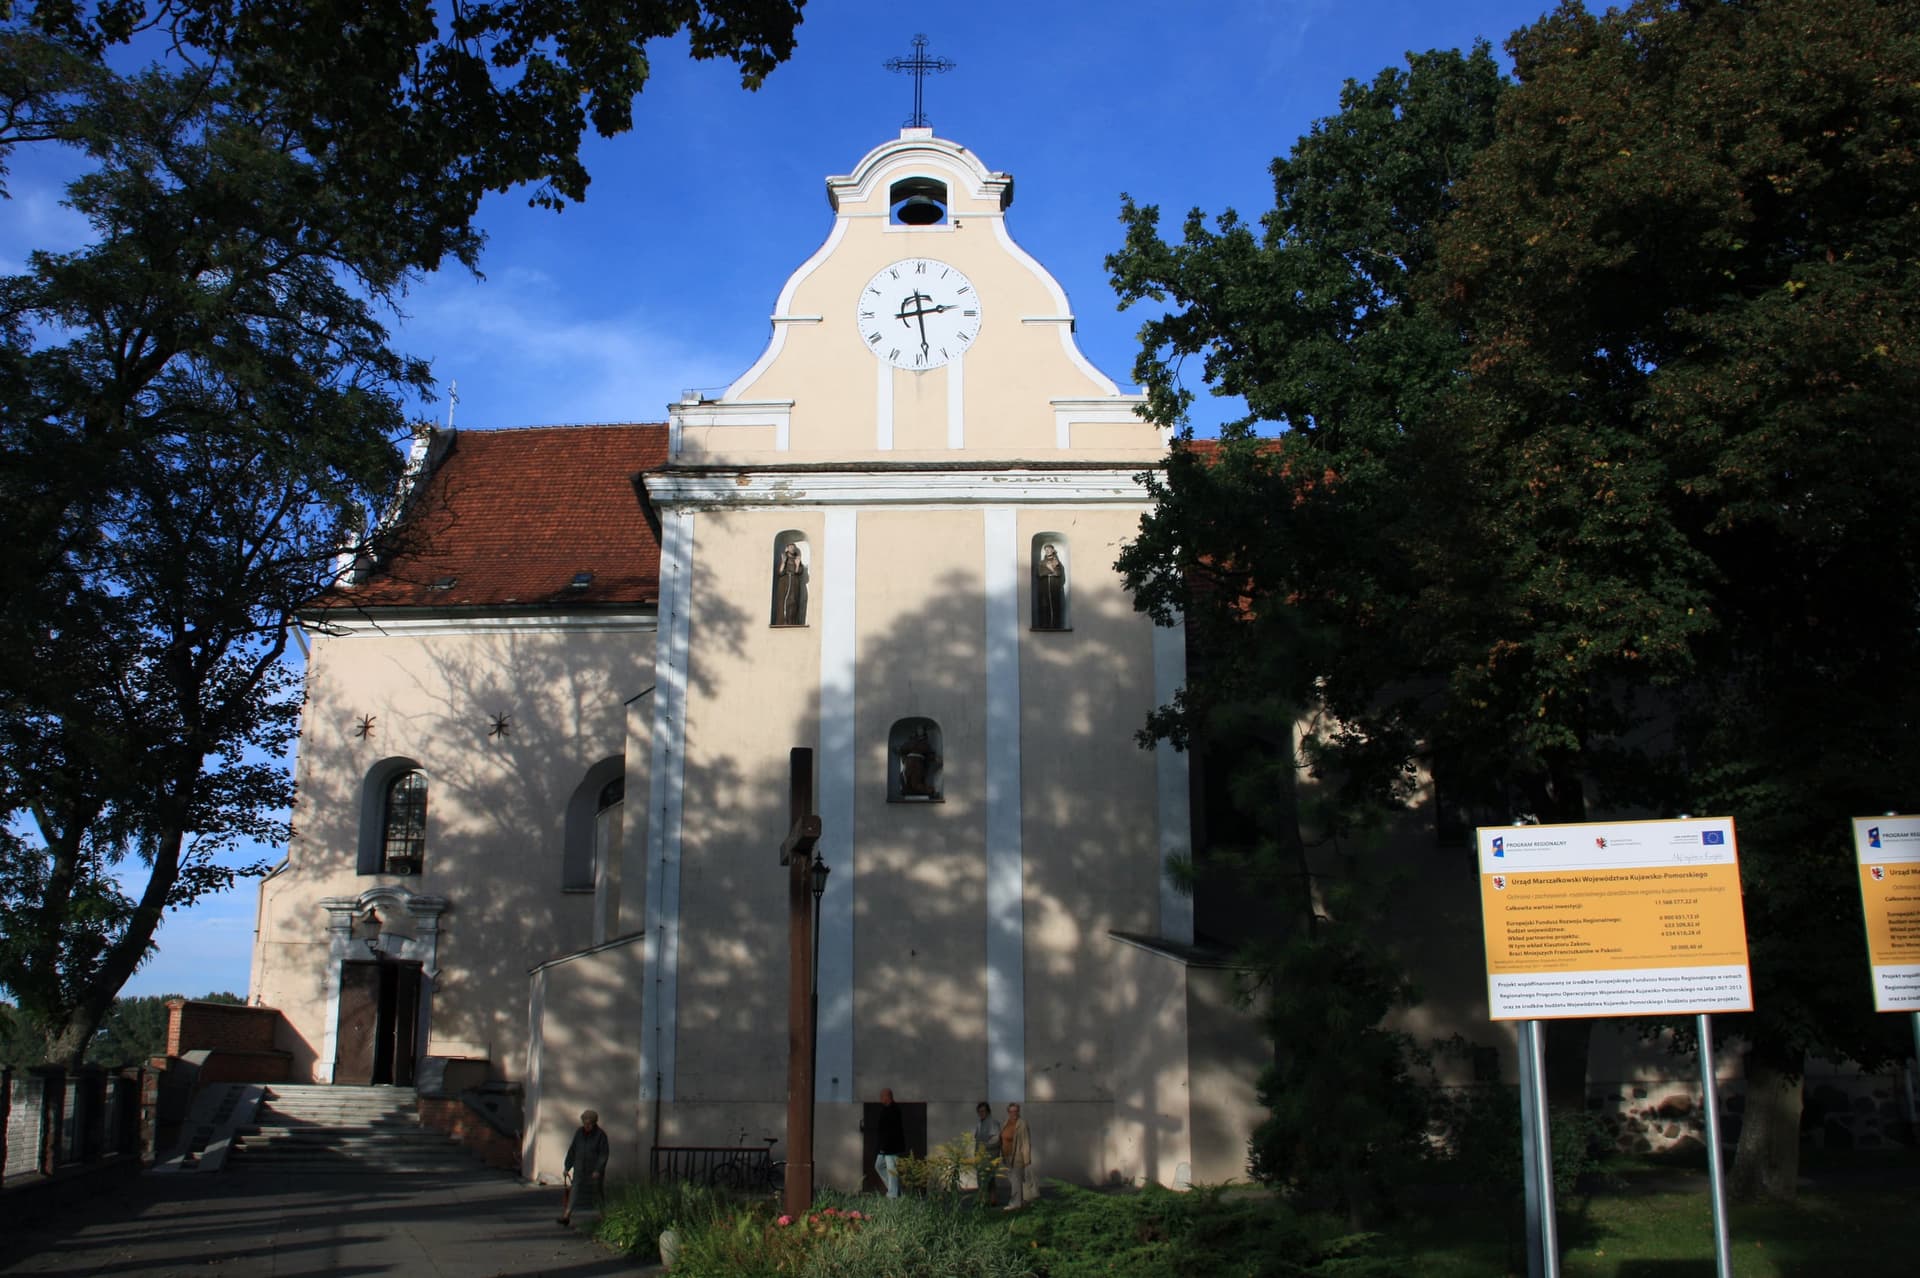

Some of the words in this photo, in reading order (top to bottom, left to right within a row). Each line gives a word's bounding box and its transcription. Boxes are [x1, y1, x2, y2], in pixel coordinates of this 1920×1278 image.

[1512, 878, 1532, 886] Urząd
[1533, 876, 1581, 885] Marszałkowski
[1582, 874, 1628, 883] Województwa
[1630, 872, 1708, 882] Kujawsko-Pomorskiego
[1524, 949, 1553, 957] Mniejszych
[1604, 999, 1663, 1007] Kujawsko-Pomorskiego
